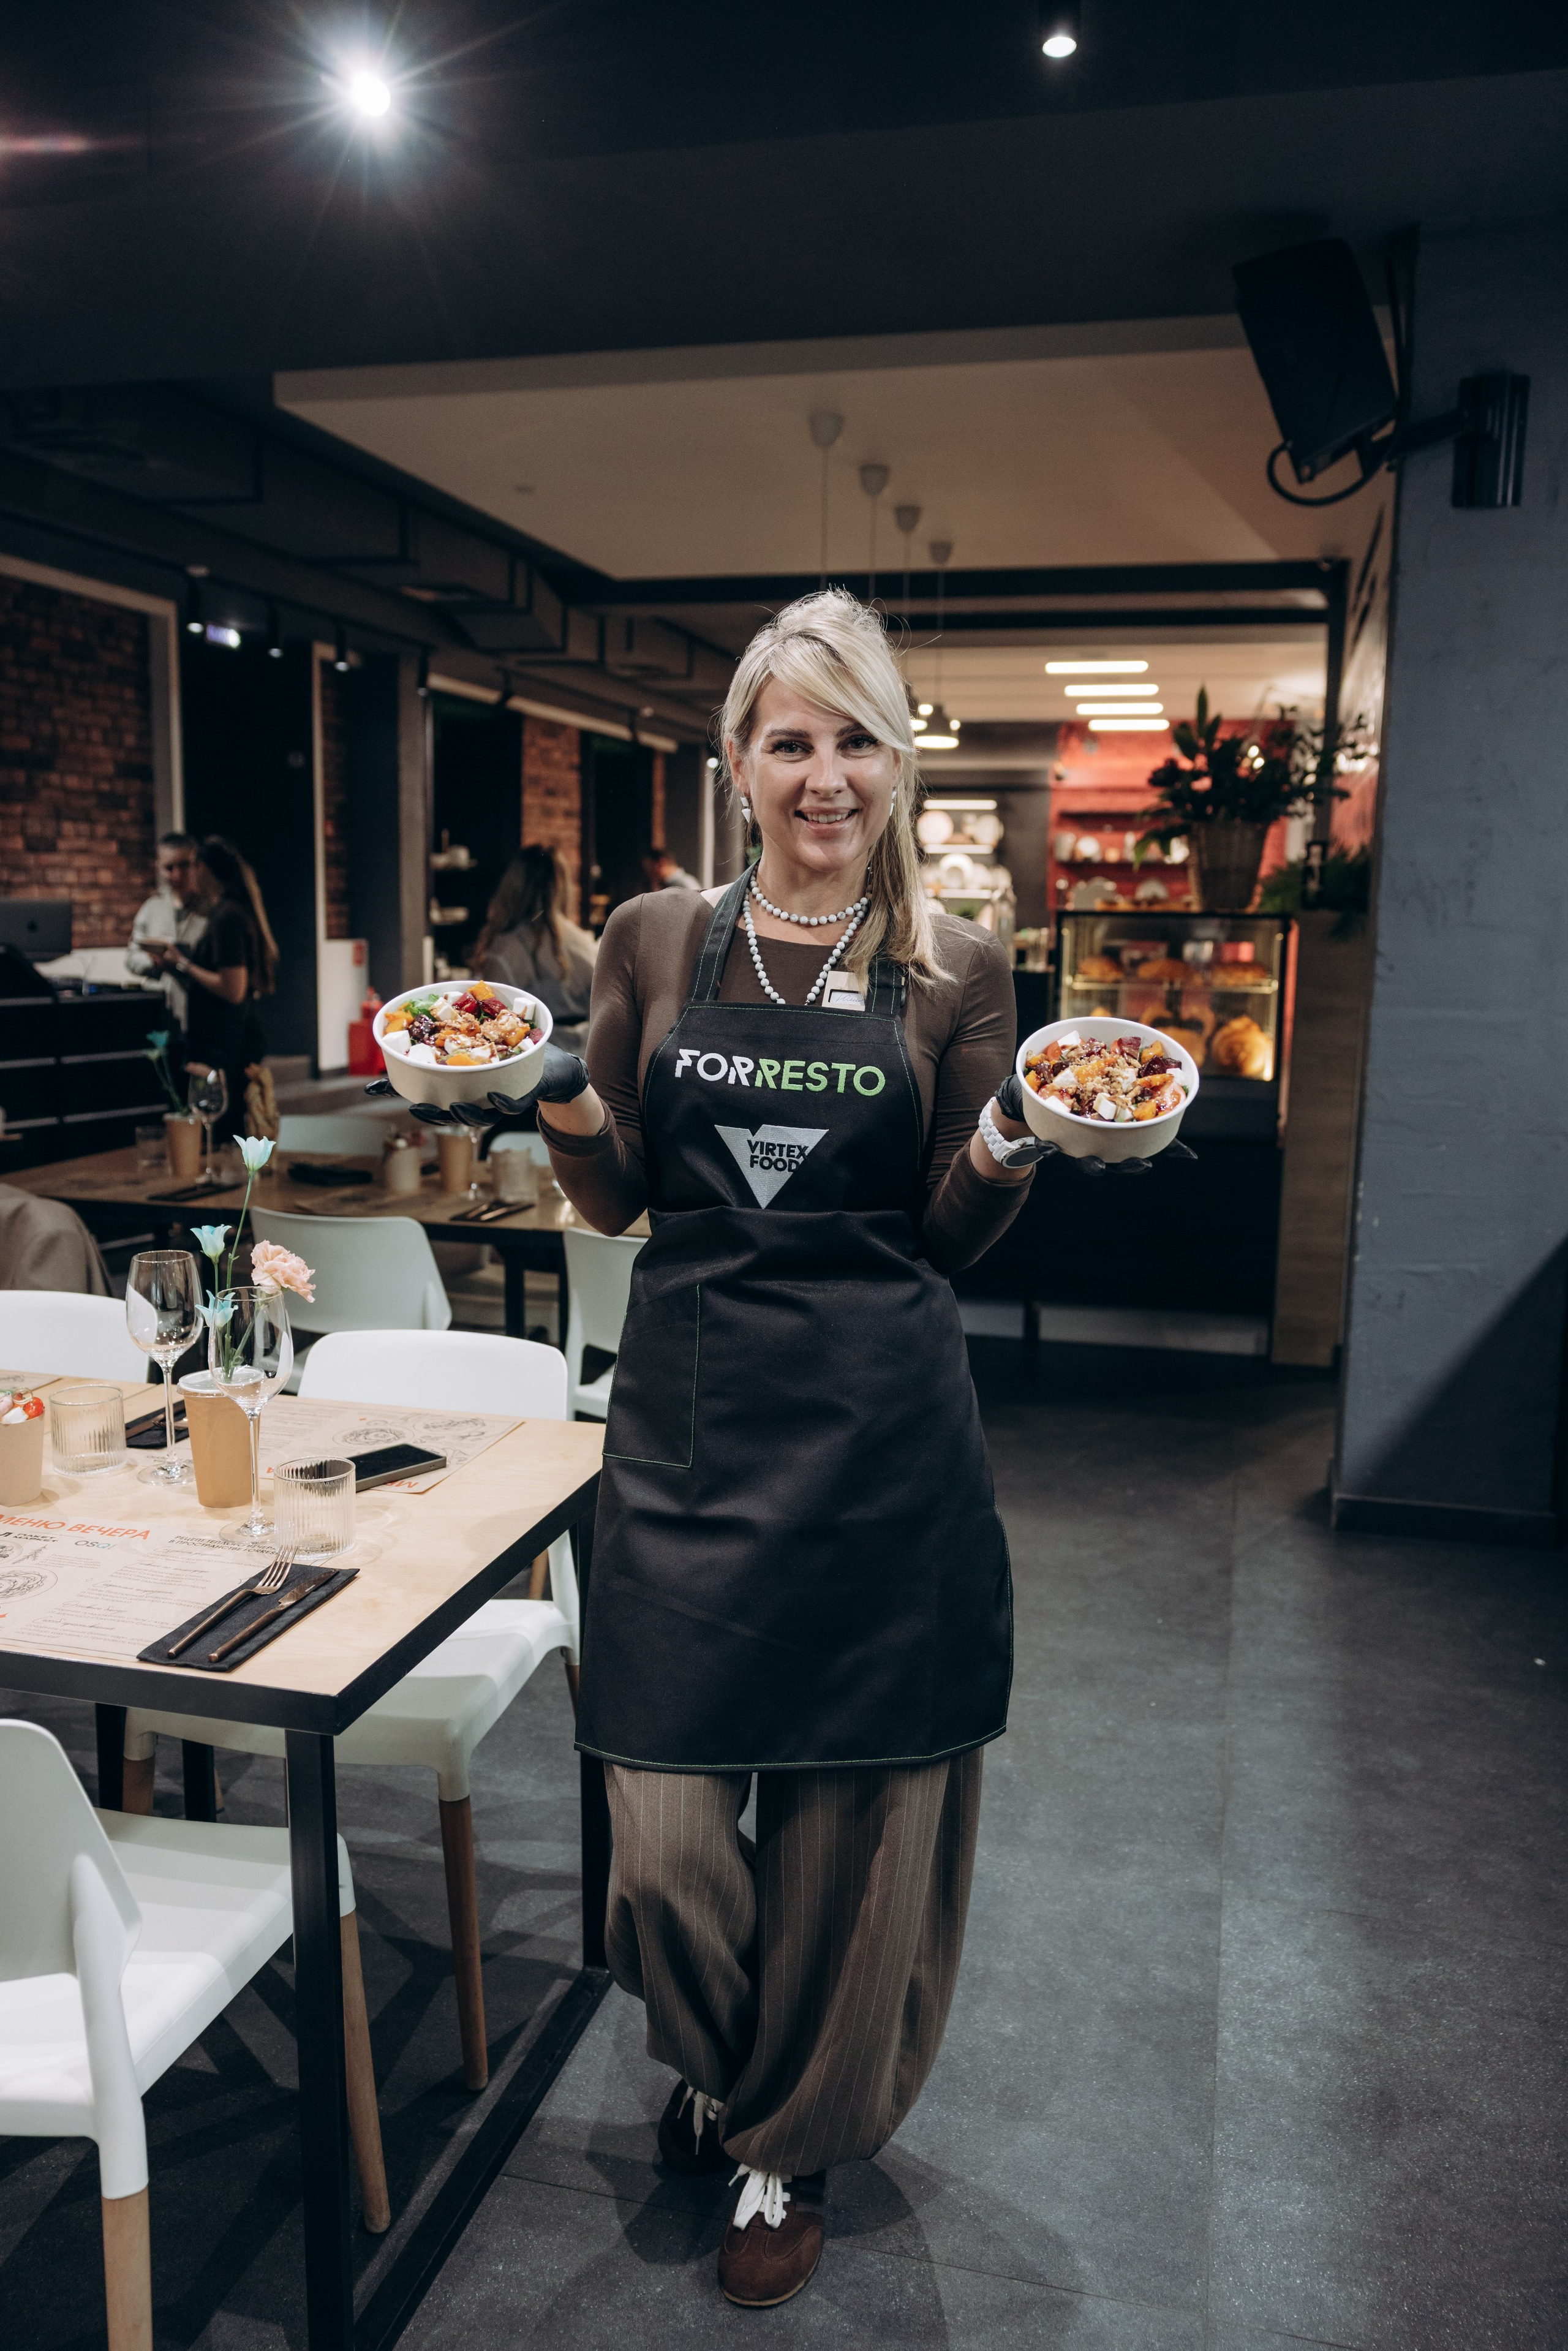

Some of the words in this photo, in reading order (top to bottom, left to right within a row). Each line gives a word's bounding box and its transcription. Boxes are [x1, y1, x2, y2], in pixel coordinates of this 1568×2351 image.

[675, 1048, 886, 1096] FORRESTO
[747, 1139, 809, 1159] VIRTEX
[750, 1155, 802, 1172] FOOD
[0, 1514, 66, 1529] МЕНЮ
[67, 1523, 150, 1539] ВЕЧЕРА
[75, 1540, 111, 1549] OSQ
[176, 1541, 243, 1551] ПРОСТРАНСТВЕ
